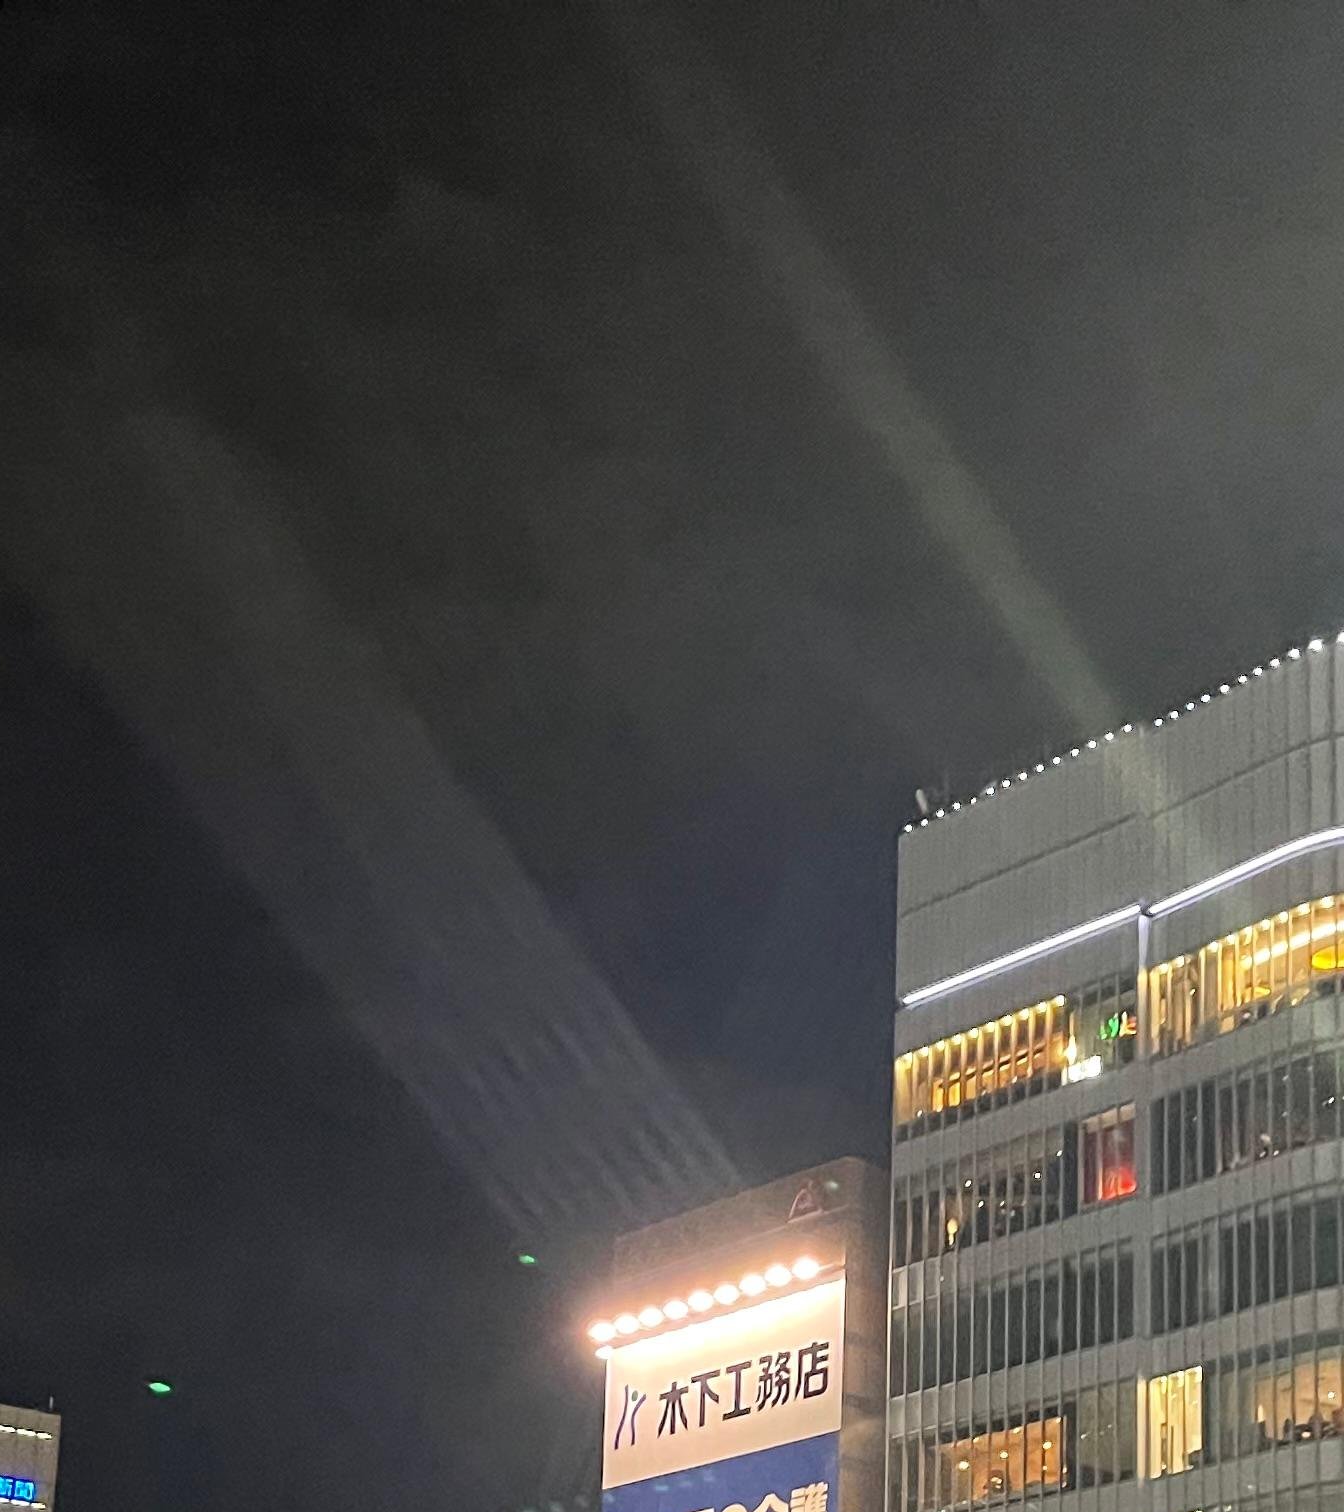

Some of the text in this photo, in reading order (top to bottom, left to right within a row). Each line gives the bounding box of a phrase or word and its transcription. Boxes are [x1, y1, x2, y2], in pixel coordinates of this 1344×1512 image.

[657, 1342, 830, 1439] 木下工務店
